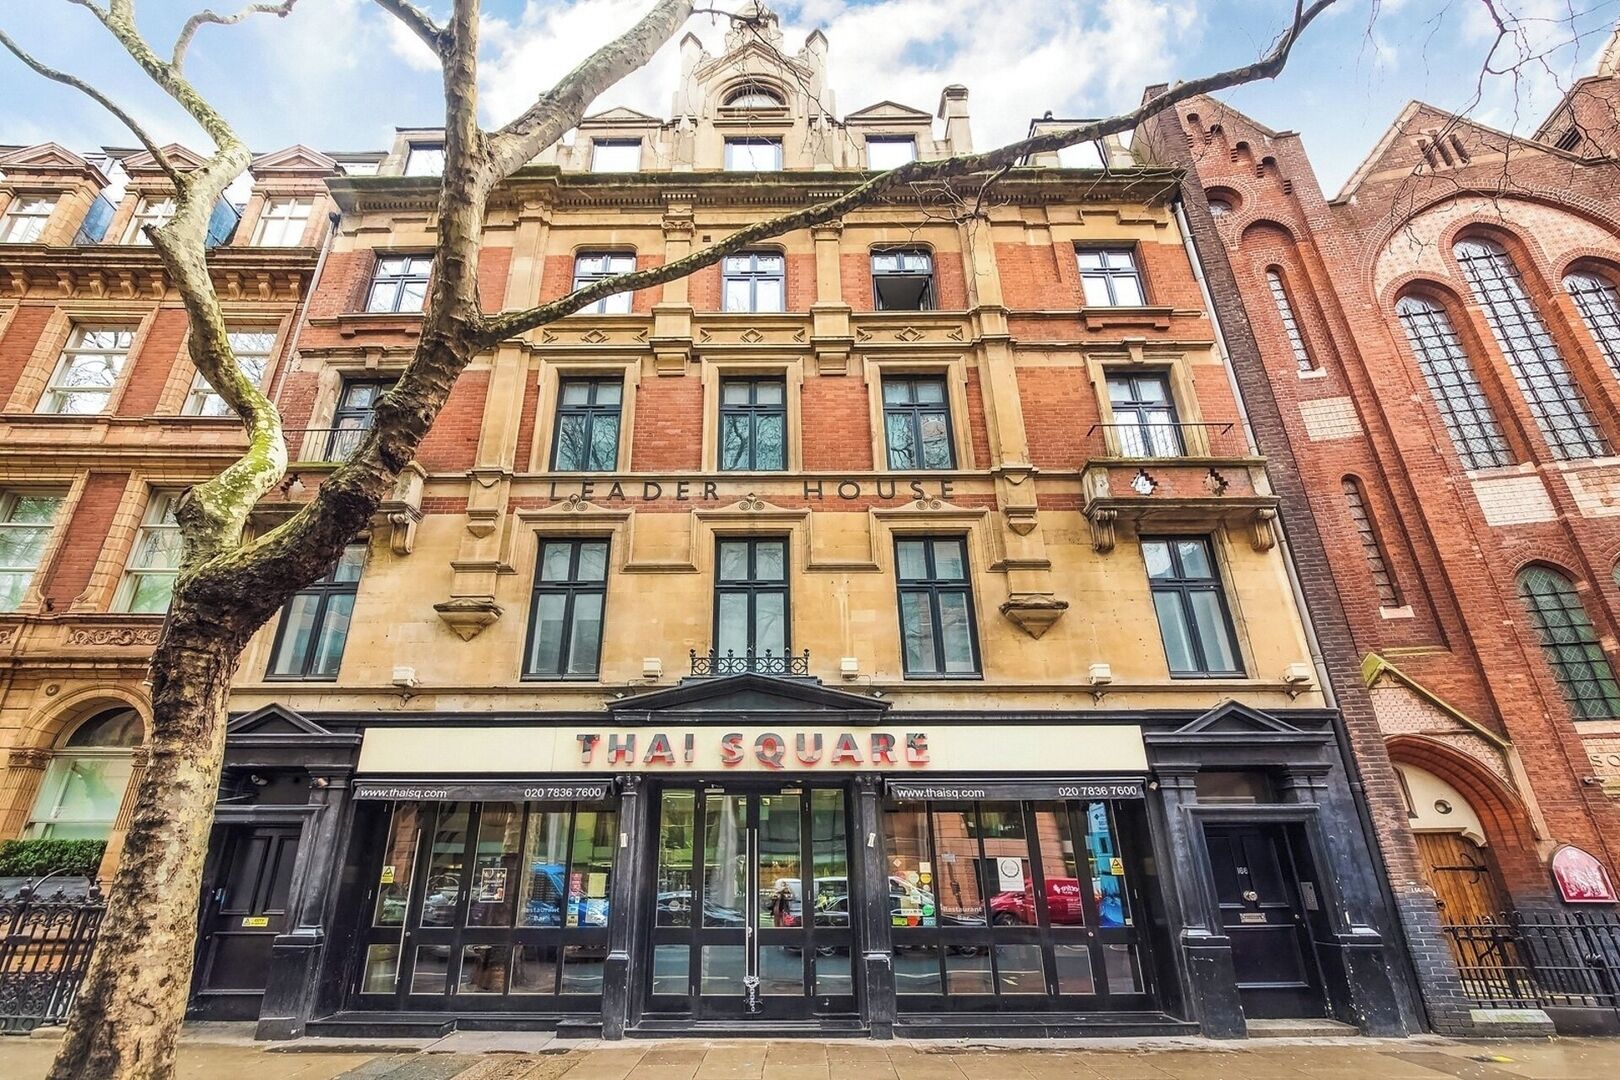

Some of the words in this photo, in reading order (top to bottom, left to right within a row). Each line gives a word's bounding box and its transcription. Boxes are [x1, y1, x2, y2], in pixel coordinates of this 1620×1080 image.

[550, 480, 720, 501] LEADER
[803, 480, 955, 500] HOUSE
[576, 733, 695, 764] THAI
[721, 732, 931, 768] SQUARE
[360, 788, 447, 798] www.thaisq.com
[524, 788, 544, 798] 020
[547, 788, 573, 797] 7836
[576, 787, 601, 797] 7600
[897, 787, 985, 799] www.thaisq.com
[1058, 787, 1079, 797] 020
[1081, 787, 1108, 797] 7836
[1111, 786, 1137, 796] 7600
